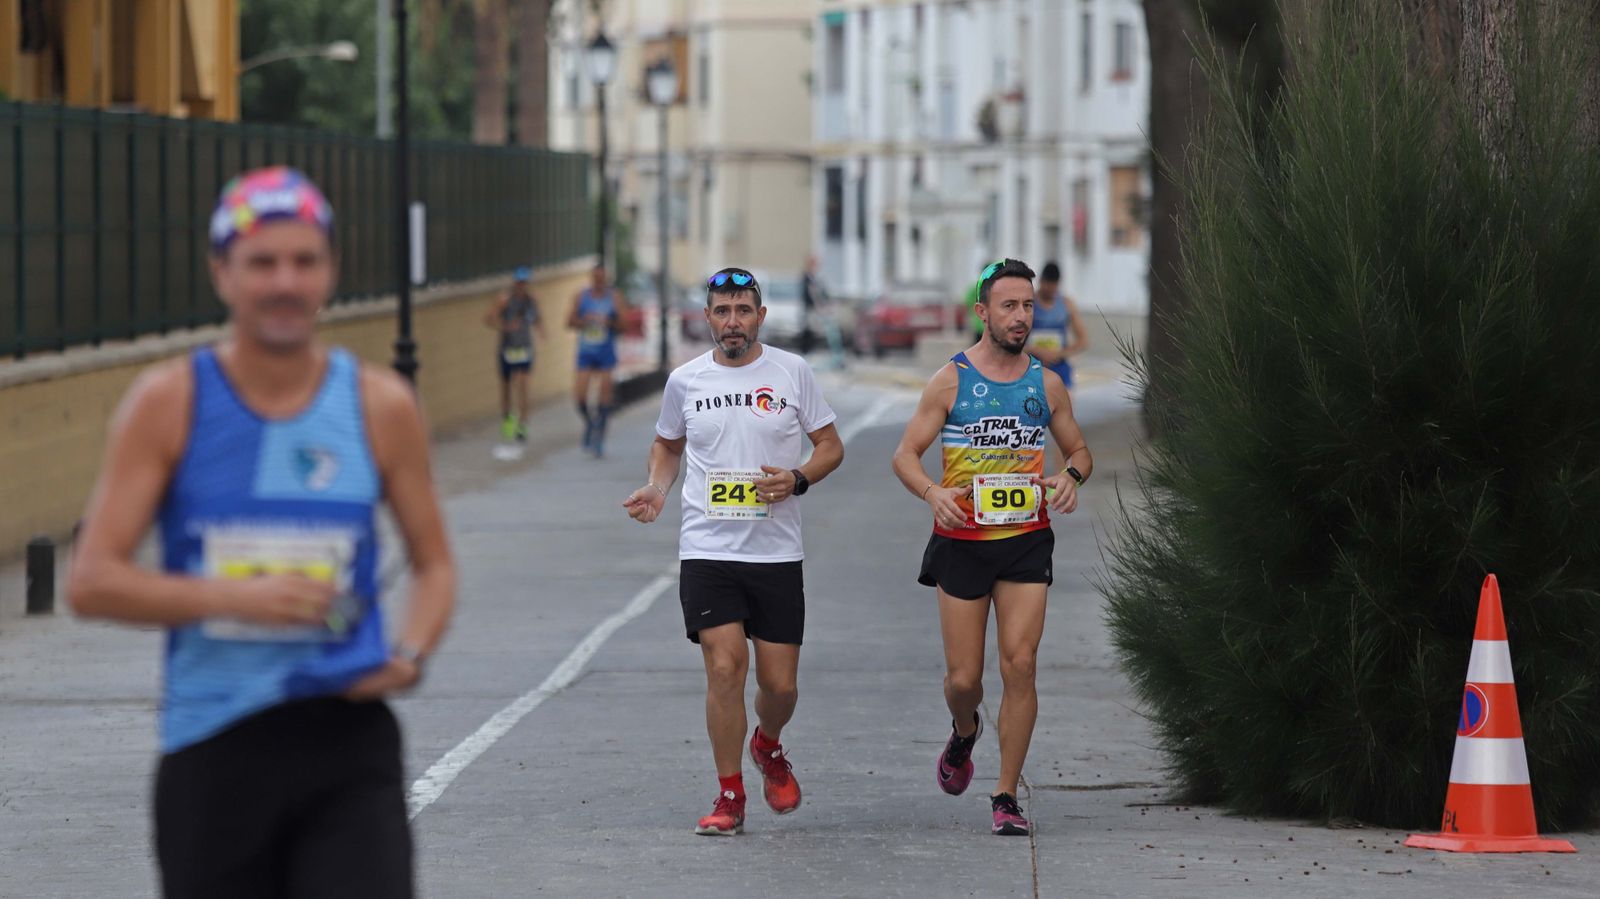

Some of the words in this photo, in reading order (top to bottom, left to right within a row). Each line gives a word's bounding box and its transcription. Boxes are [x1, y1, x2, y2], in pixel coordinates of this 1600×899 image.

[982, 418, 1018, 433] TRAIL
[973, 434, 1010, 447] TEAM
[1010, 428, 1041, 449] 3x4
[991, 489, 1026, 508] 90
